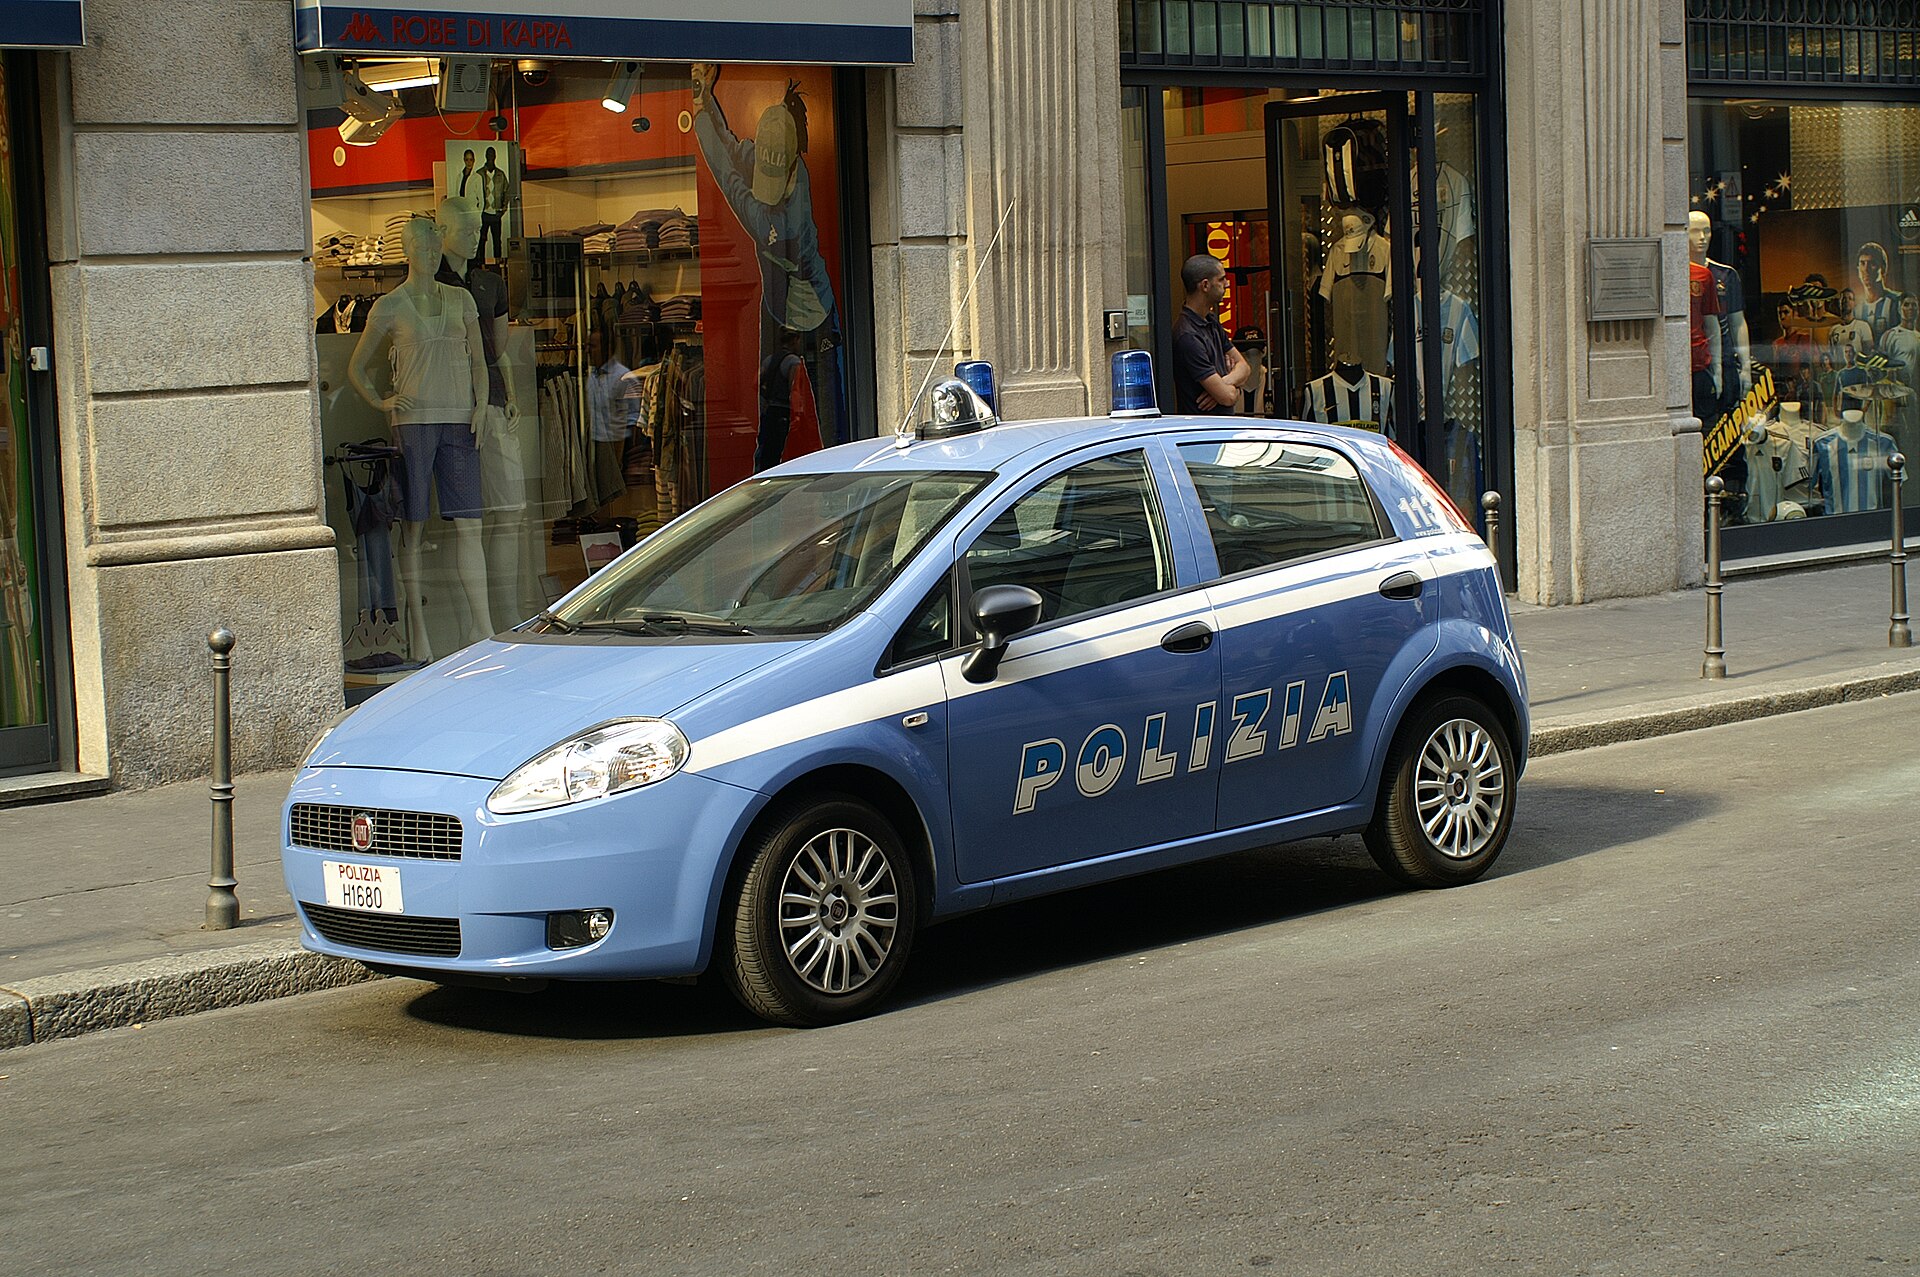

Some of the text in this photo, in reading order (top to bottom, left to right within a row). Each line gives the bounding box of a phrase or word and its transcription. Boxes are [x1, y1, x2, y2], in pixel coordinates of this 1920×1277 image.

[391, 16, 574, 49] ROBE DI KAPPA
[1711, 368, 1776, 462] CAMPIONI
[1012, 670, 1353, 815] POLIZIA
[355, 825, 368, 842] FIAT
[338, 864, 382, 882] POLIZIA
[342, 884, 382, 908] H1680
